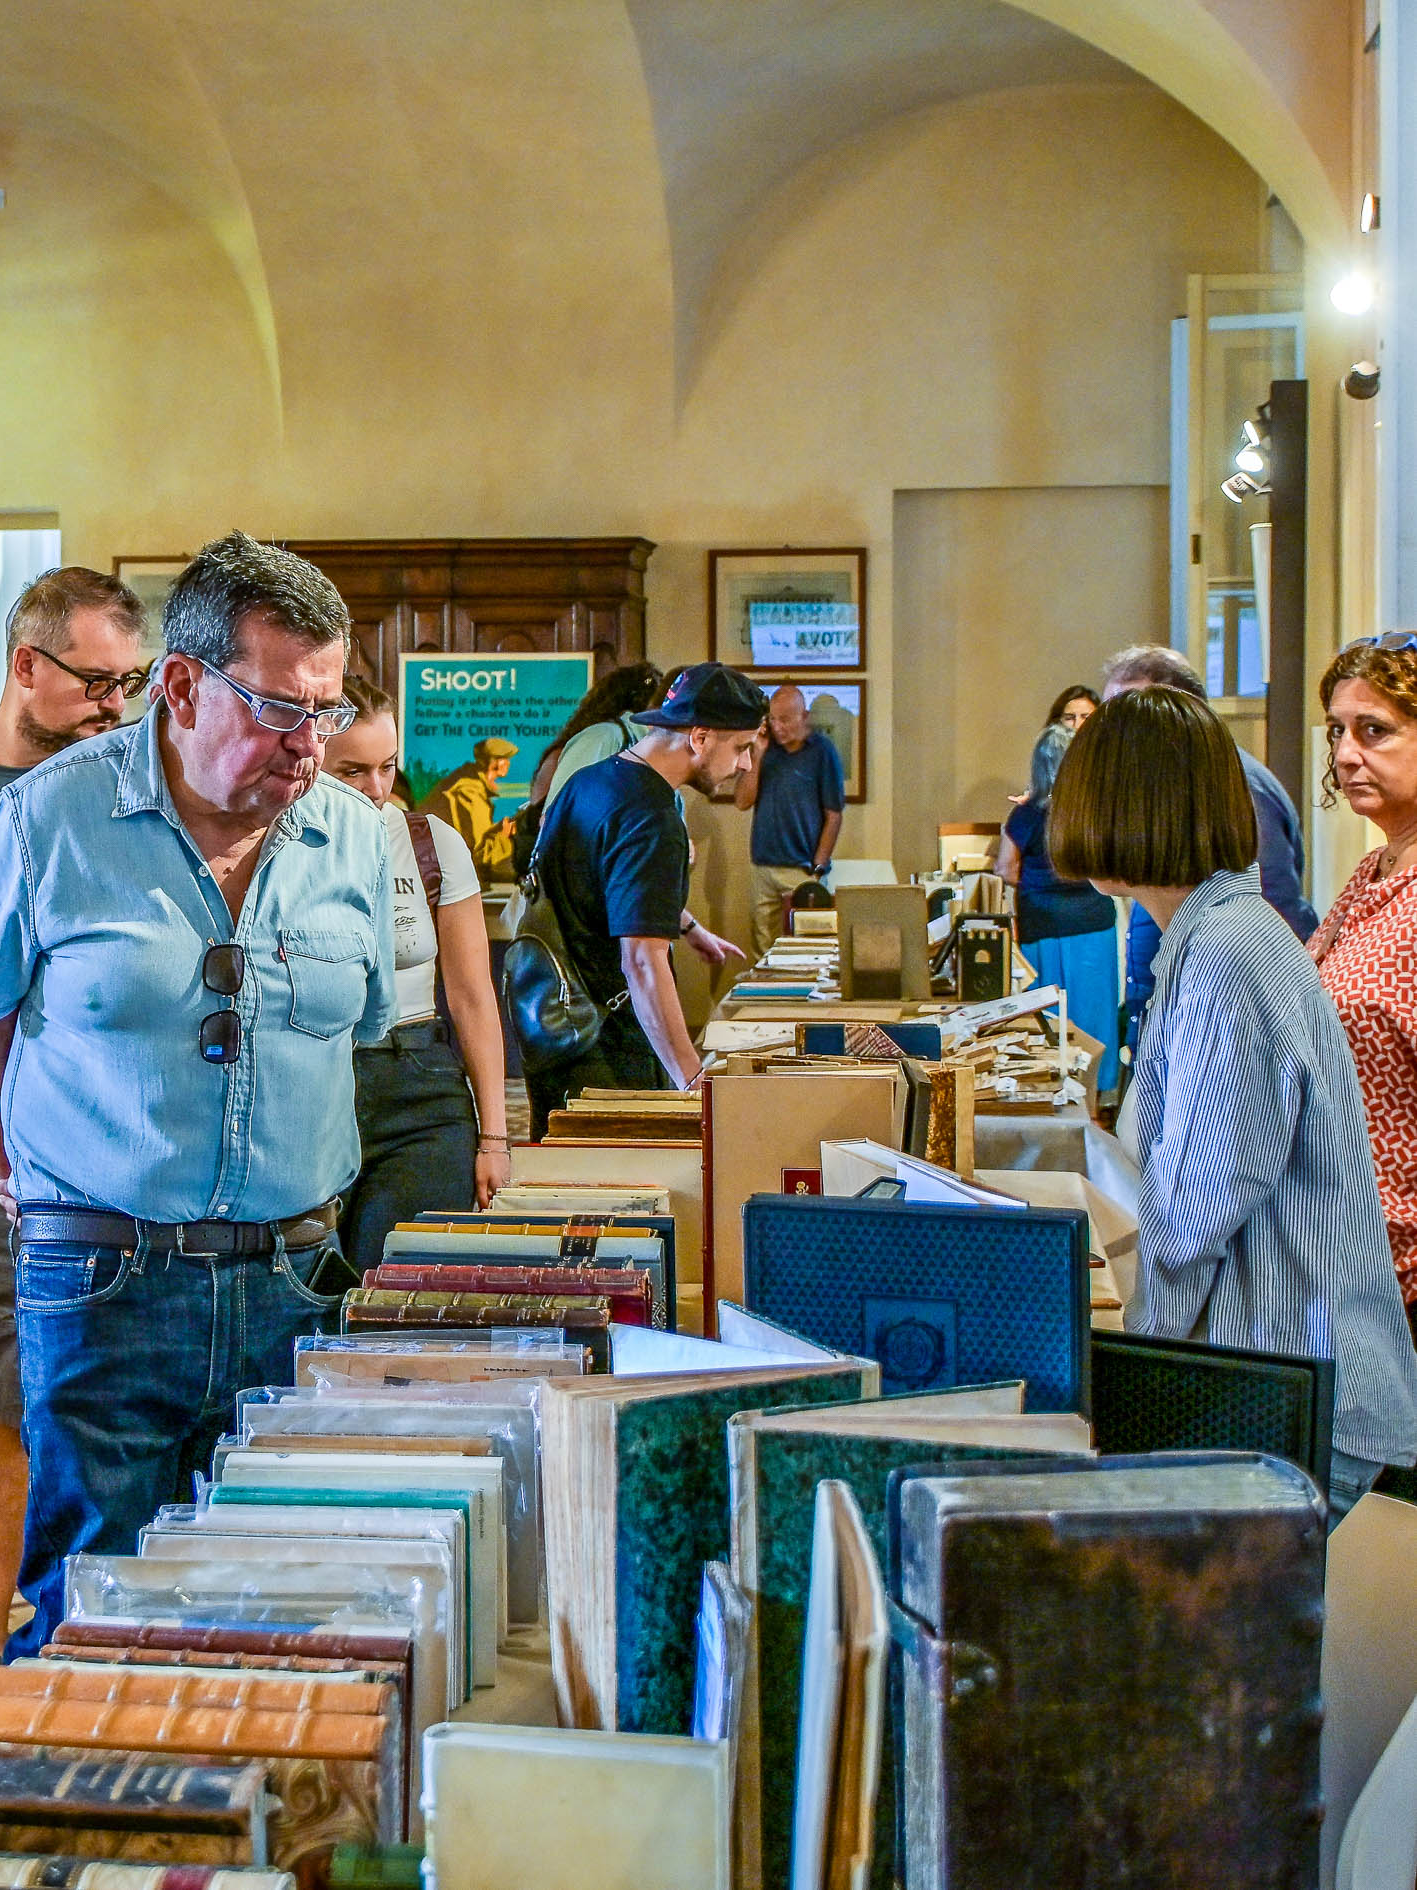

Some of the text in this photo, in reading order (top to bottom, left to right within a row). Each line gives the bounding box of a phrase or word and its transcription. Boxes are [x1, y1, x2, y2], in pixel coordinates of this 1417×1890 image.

[420, 667, 517, 692] SHOOT!
[458, 695, 468, 705] it
[470, 695, 487, 705] off
[490, 695, 521, 708] gives
[525, 695, 544, 705] the
[465, 708, 505, 718] chance
[509, 709, 520, 718] to
[524, 708, 539, 718] do
[542, 708, 551, 718] it
[414, 723, 439, 737] GET
[442, 723, 463, 737] THE
[468, 723, 509, 737] CREDIT
[393, 877, 415, 895] IN
